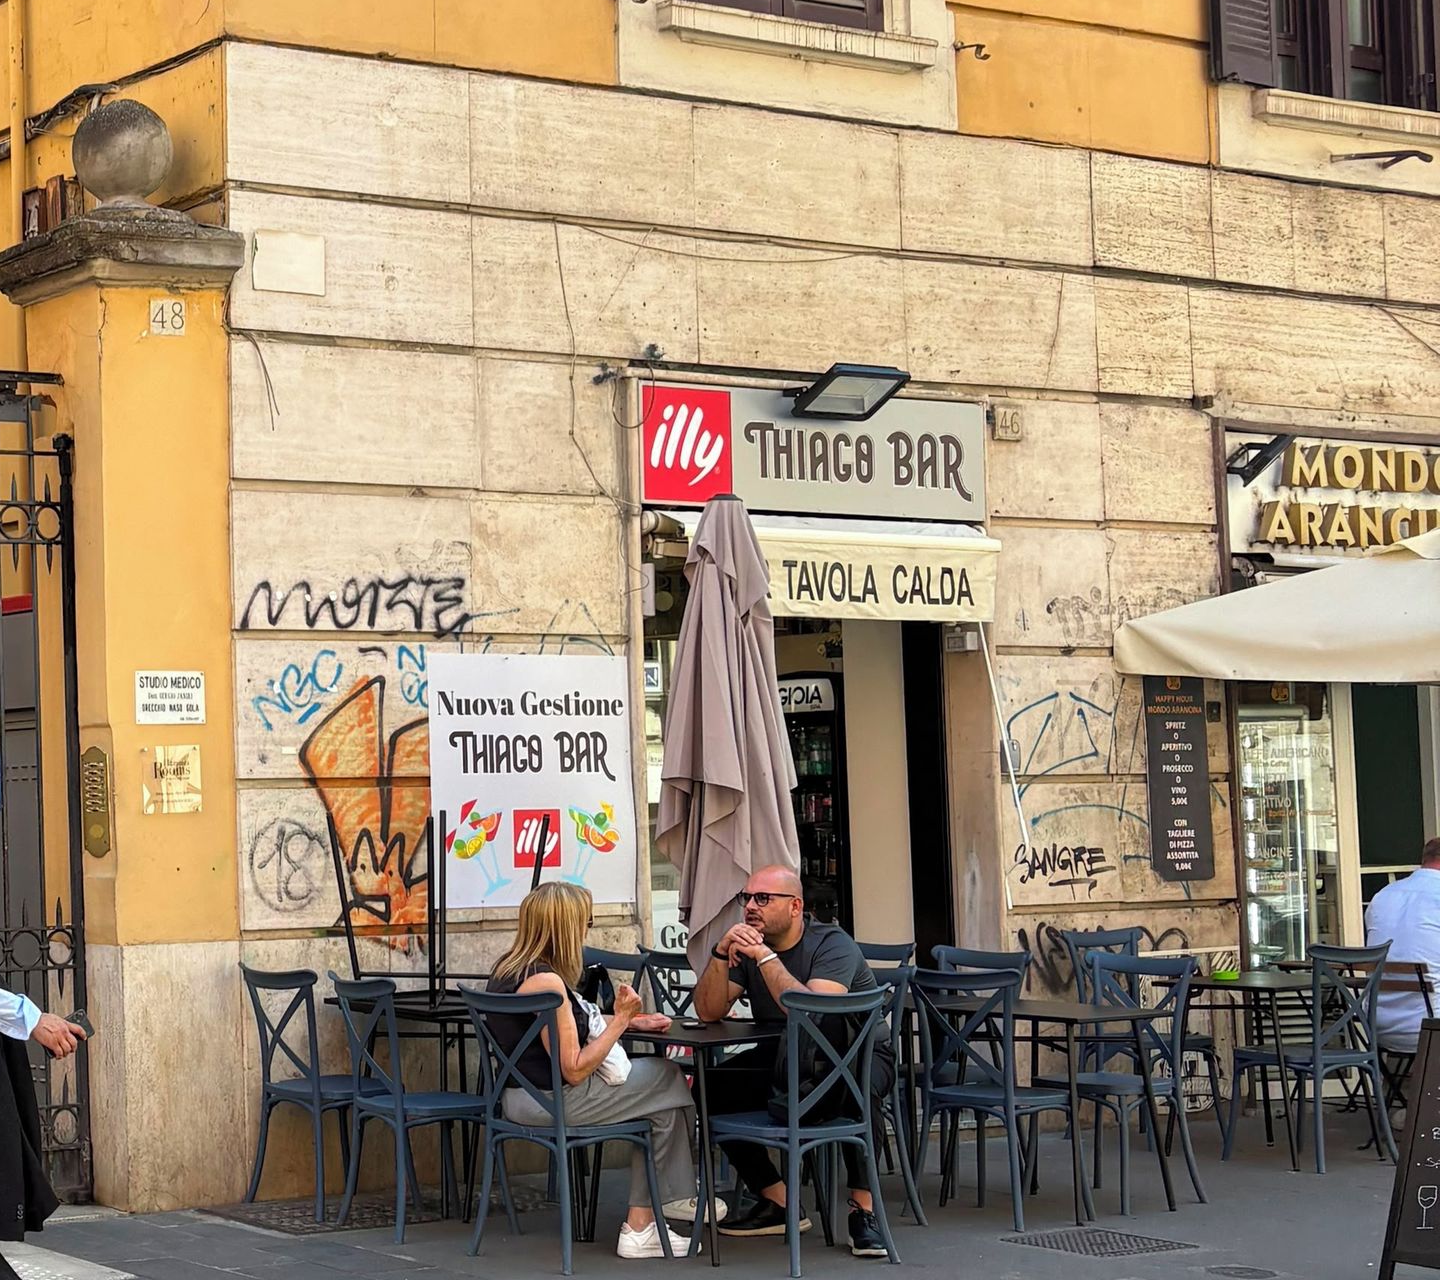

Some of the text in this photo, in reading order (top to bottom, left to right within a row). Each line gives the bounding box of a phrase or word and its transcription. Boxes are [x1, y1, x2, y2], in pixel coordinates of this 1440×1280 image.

[152, 302, 185, 329] 48
[1000, 410, 1020, 435] 46
[650, 403, 724, 486] illy
[744, 421, 974, 502] THIAGO BAR
[1291, 442, 1440, 492] MOND
[1266, 500, 1440, 548] ARANCI
[782, 560, 879, 604] TAVOLA
[893, 565, 974, 606] CALDA
[139, 676, 201, 689] STUDIO MEDICO
[169, 704, 182, 712] NASO
[186, 704, 199, 712] GOLA
[437, 691, 624, 716] Nuova Gestione
[1147, 705, 1171, 714] MONDO
[1165, 721, 1186, 729] SPRITZ
[449, 731, 616, 782] THIAGO BAR
[1161, 743, 1192, 751] APERITIVO
[1162, 765, 1193, 773] PROSECCO
[1174, 819, 1187, 827] CON
[1166, 851, 1199, 859] ASSORTITA
